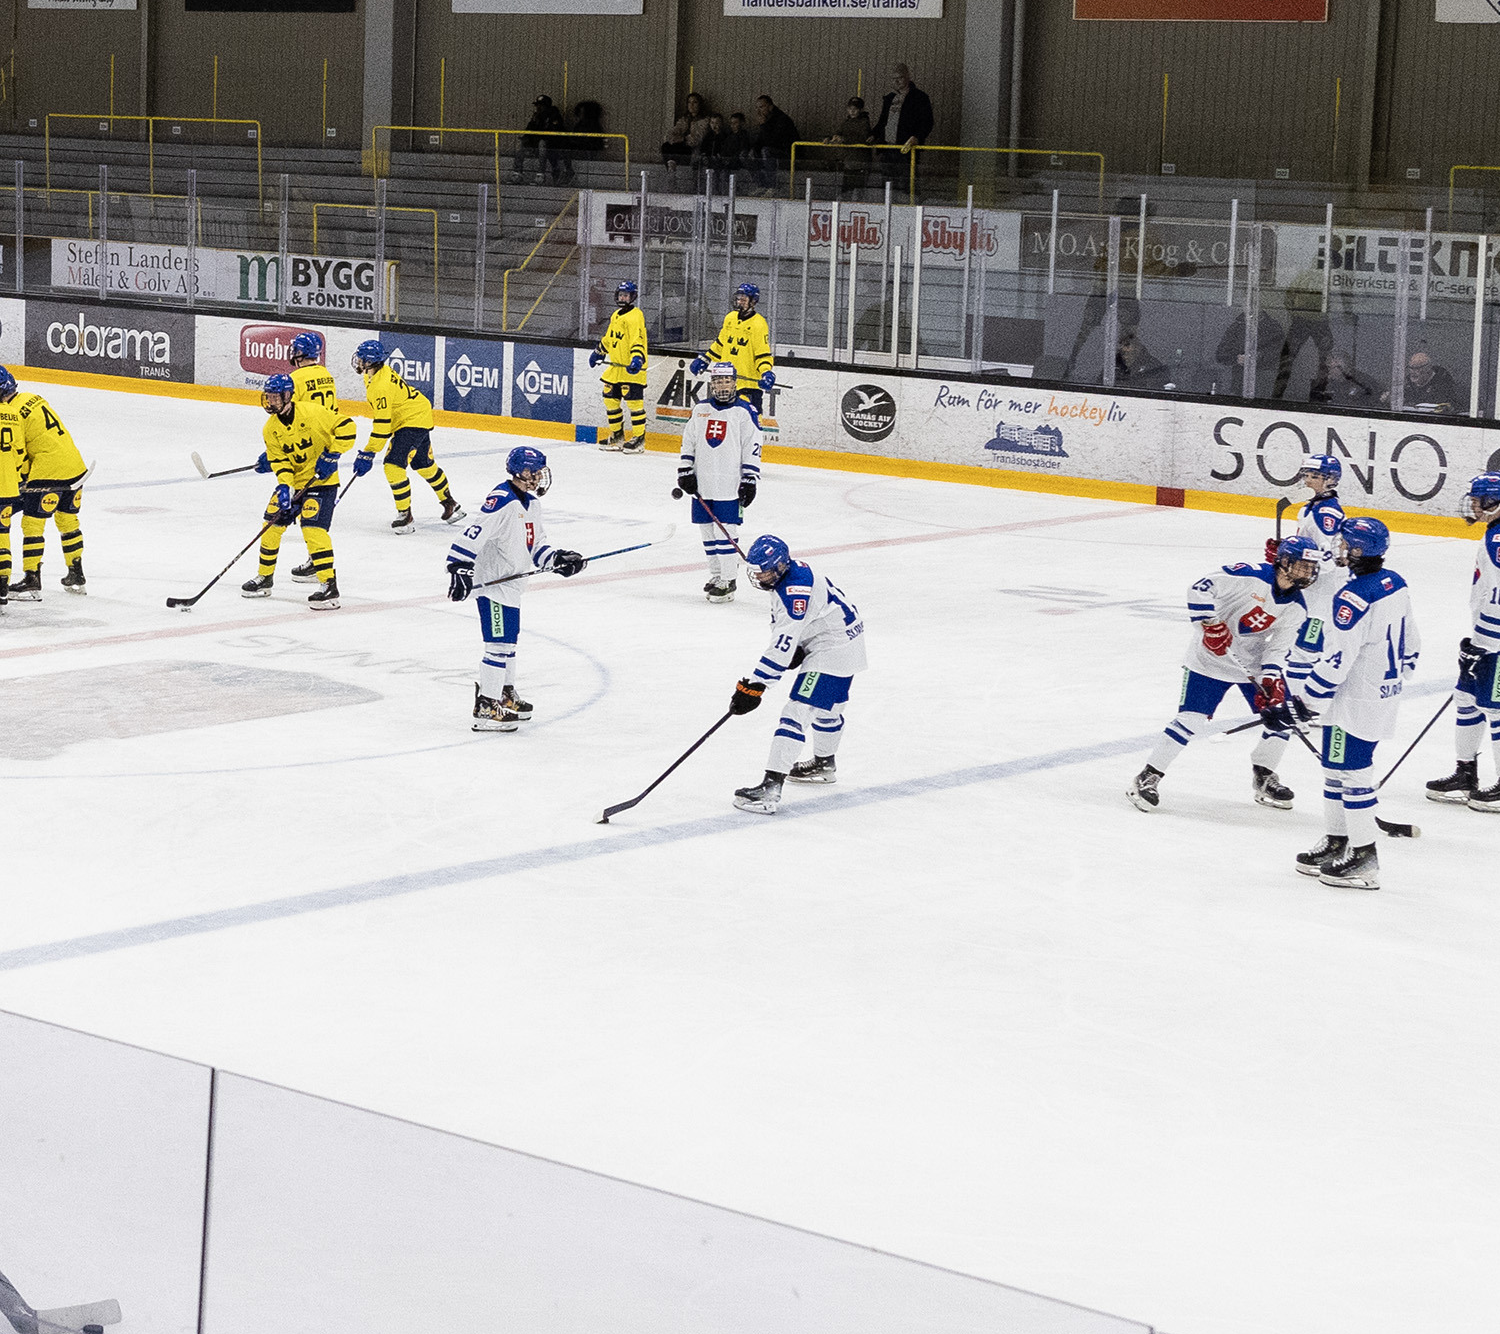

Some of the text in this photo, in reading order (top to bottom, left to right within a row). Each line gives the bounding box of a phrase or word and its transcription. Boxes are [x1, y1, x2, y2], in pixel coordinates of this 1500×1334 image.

[307, 288, 374, 311] FÖNSTER
[46, 312, 171, 364] colorama
[140, 365, 171, 378] TRANÅS
[455, 362, 499, 390] OEM
[524, 369, 569, 395] OEM
[935, 385, 1127, 427] Rum för mer hockeyliv
[992, 452, 1062, 471] Tranåsbostäder
[1210, 415, 1449, 504] SONO
